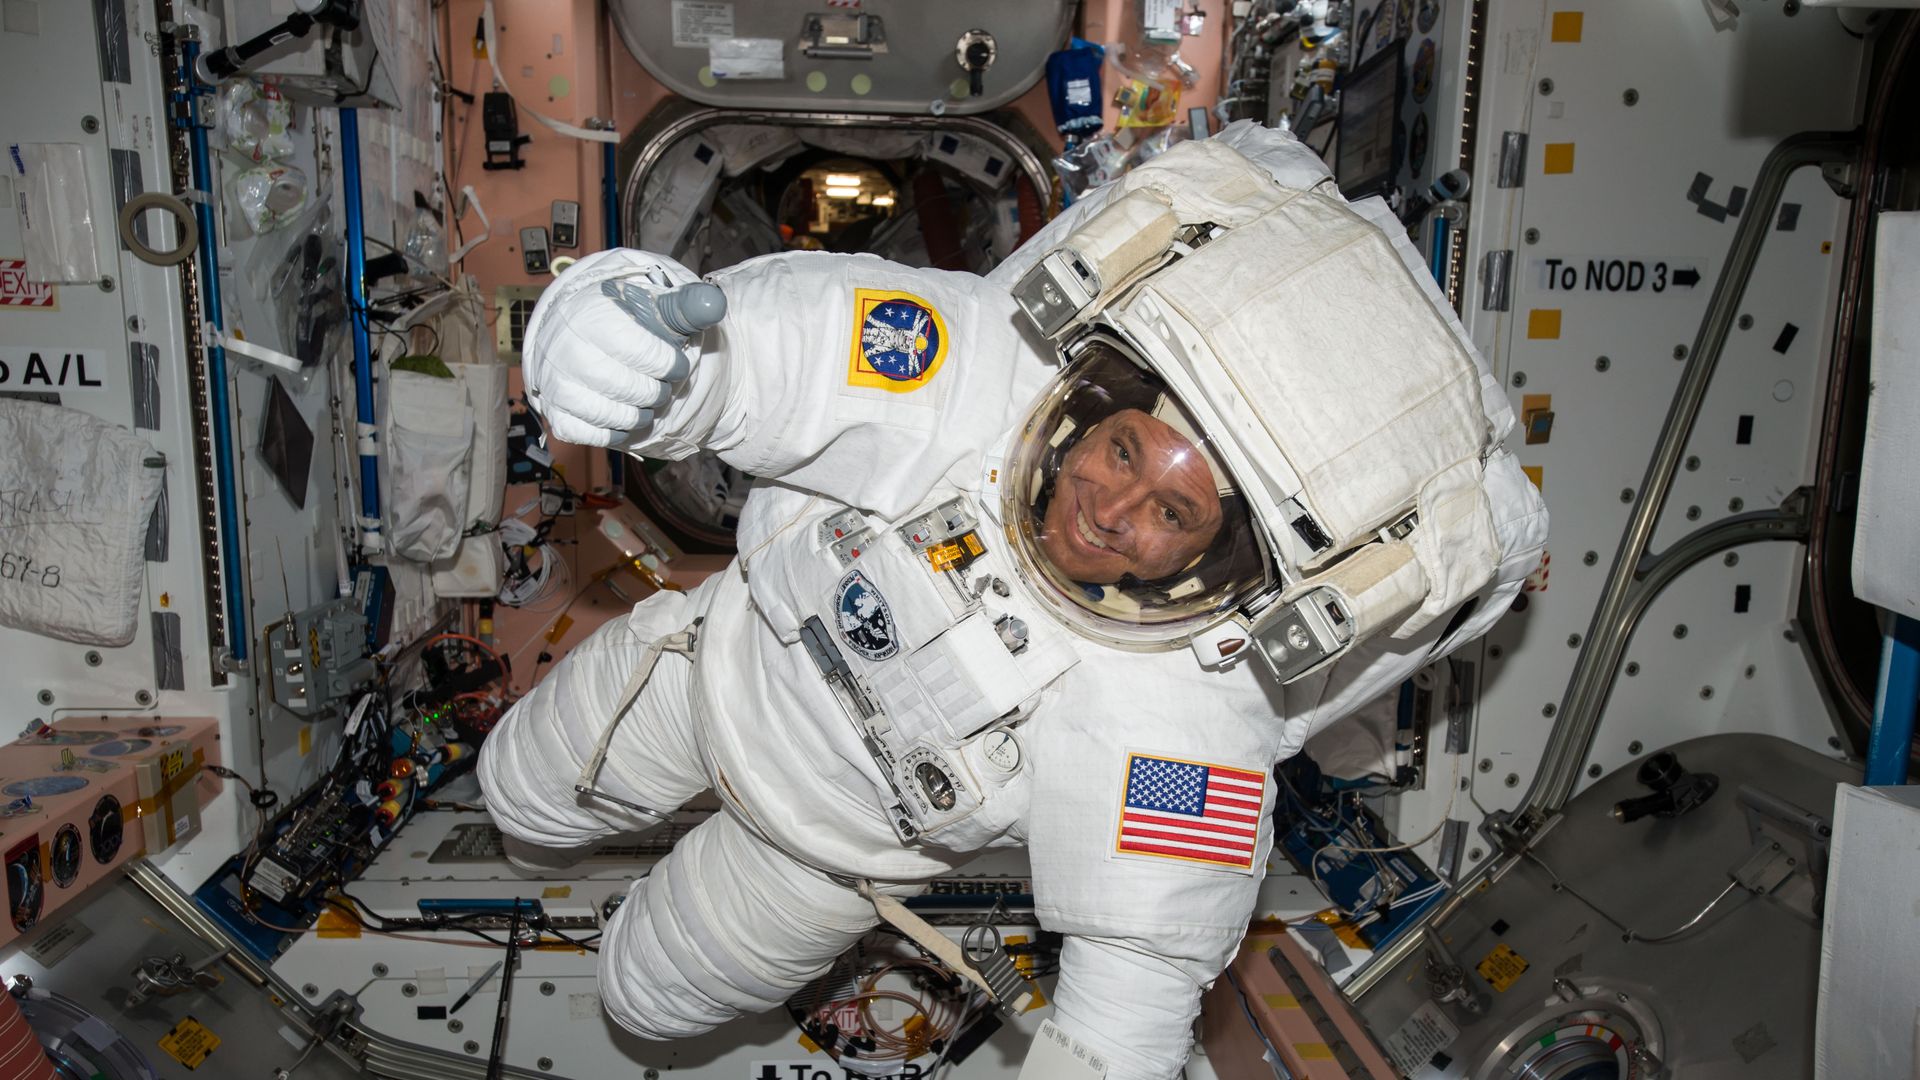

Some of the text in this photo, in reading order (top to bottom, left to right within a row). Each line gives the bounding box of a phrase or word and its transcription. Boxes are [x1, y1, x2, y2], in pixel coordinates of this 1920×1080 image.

[1545, 259, 1667, 293] To NOD 3
[23, 352, 102, 387] A/L
[870, 588, 892, 625] WHITSON
